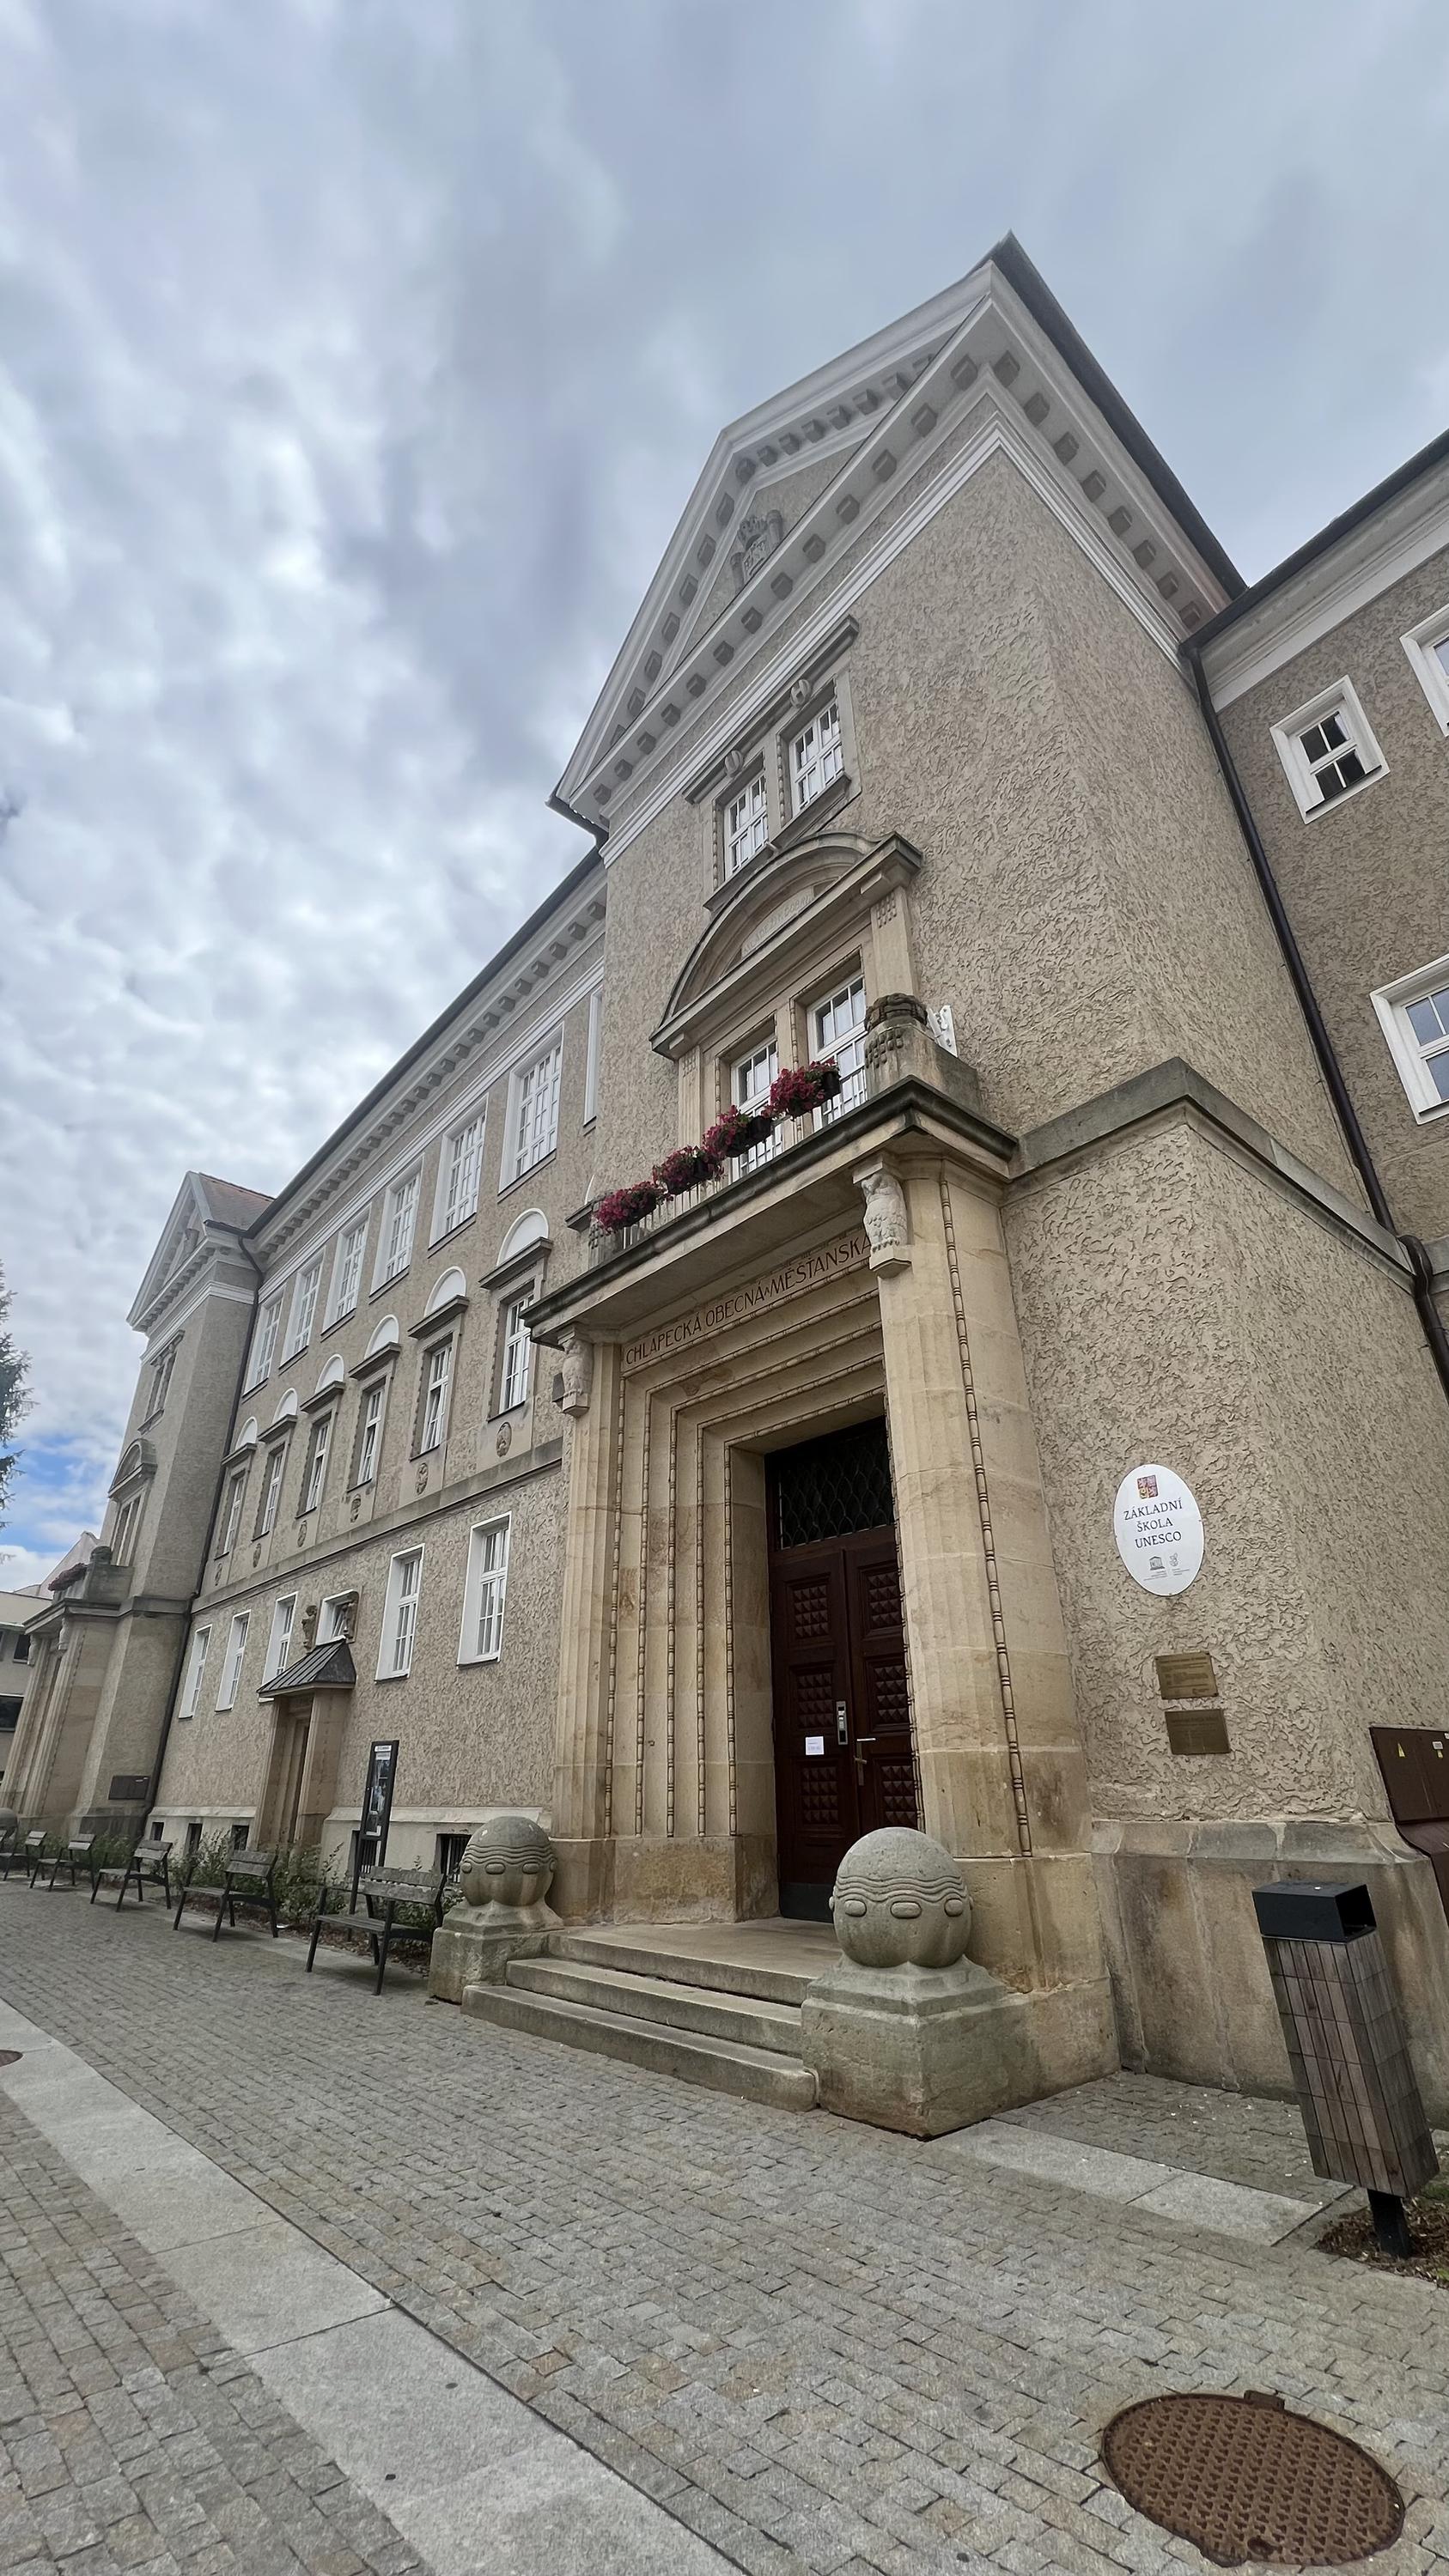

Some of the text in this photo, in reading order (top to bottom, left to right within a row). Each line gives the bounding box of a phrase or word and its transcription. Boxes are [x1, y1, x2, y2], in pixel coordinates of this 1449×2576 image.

[626, 1311, 702, 1364] CHLAPECKÁ
[705, 1280, 764, 1327] OBECNÁ
[1123, 1498, 1183, 1521] ZÁKLADNÍ
[1136, 1517, 1173, 1533] ŠKOLA
[1135, 1531, 1182, 1548] UNESCO
